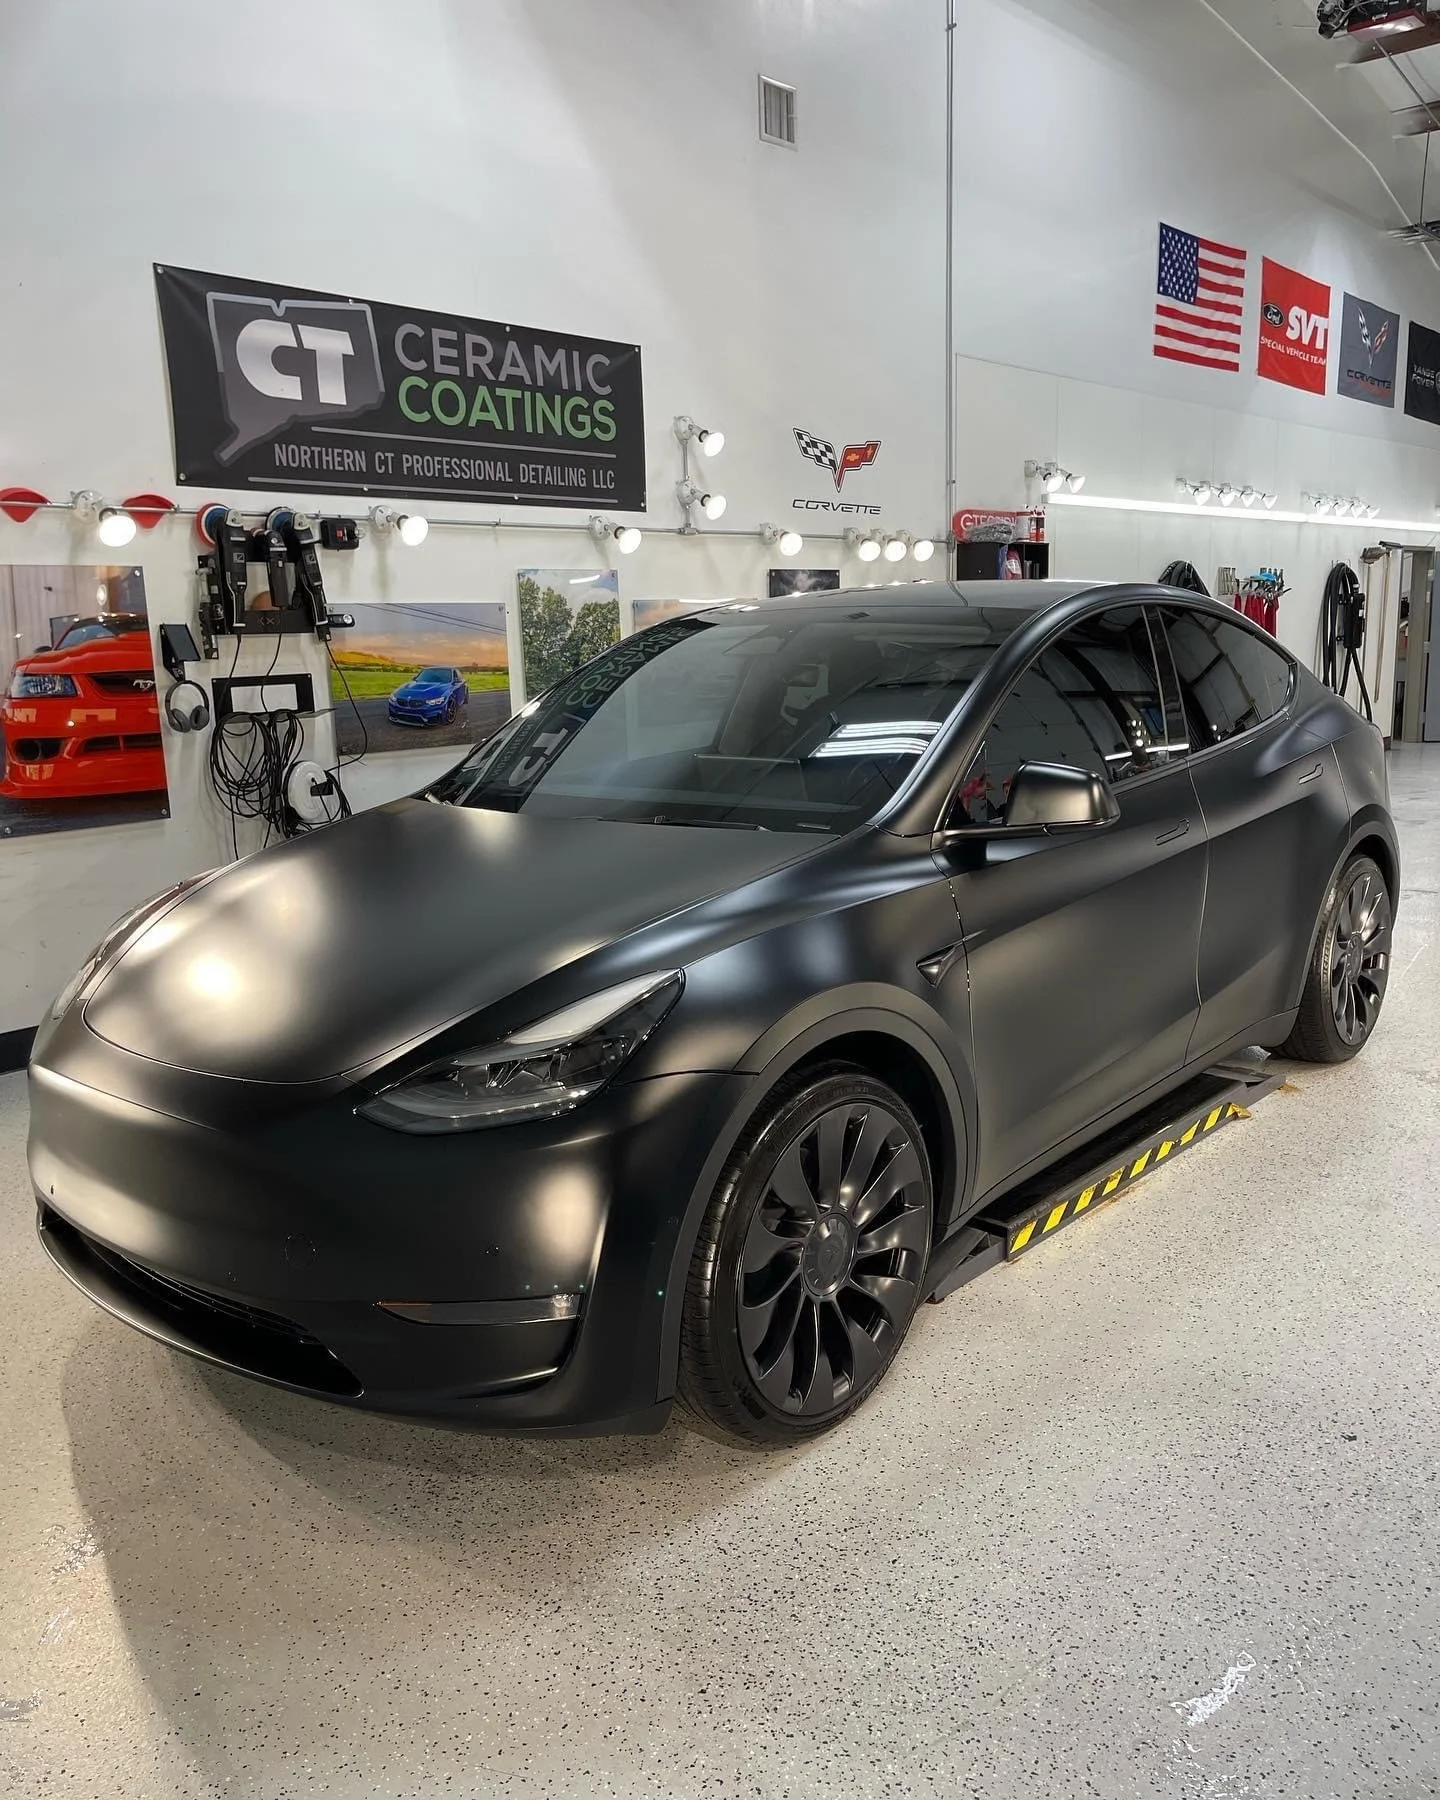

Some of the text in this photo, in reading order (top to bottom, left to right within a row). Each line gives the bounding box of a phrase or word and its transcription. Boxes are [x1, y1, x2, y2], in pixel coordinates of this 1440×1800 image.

[1260, 336, 1285, 353] SPECIAL
[1286, 346, 1310, 361] VEHICLE
[1285, 305, 1329, 350] SVT
[236, 318, 355, 406] CT
[394, 323, 613, 396] CERAMIC
[1346, 369, 1392, 389] CORVETTE
[398, 375, 617, 442] COATINGS
[274, 443, 615, 490] NORTHERN CT PROFESSIONAL DETAILING LLC
[792, 499, 882, 515] CORVETTE
